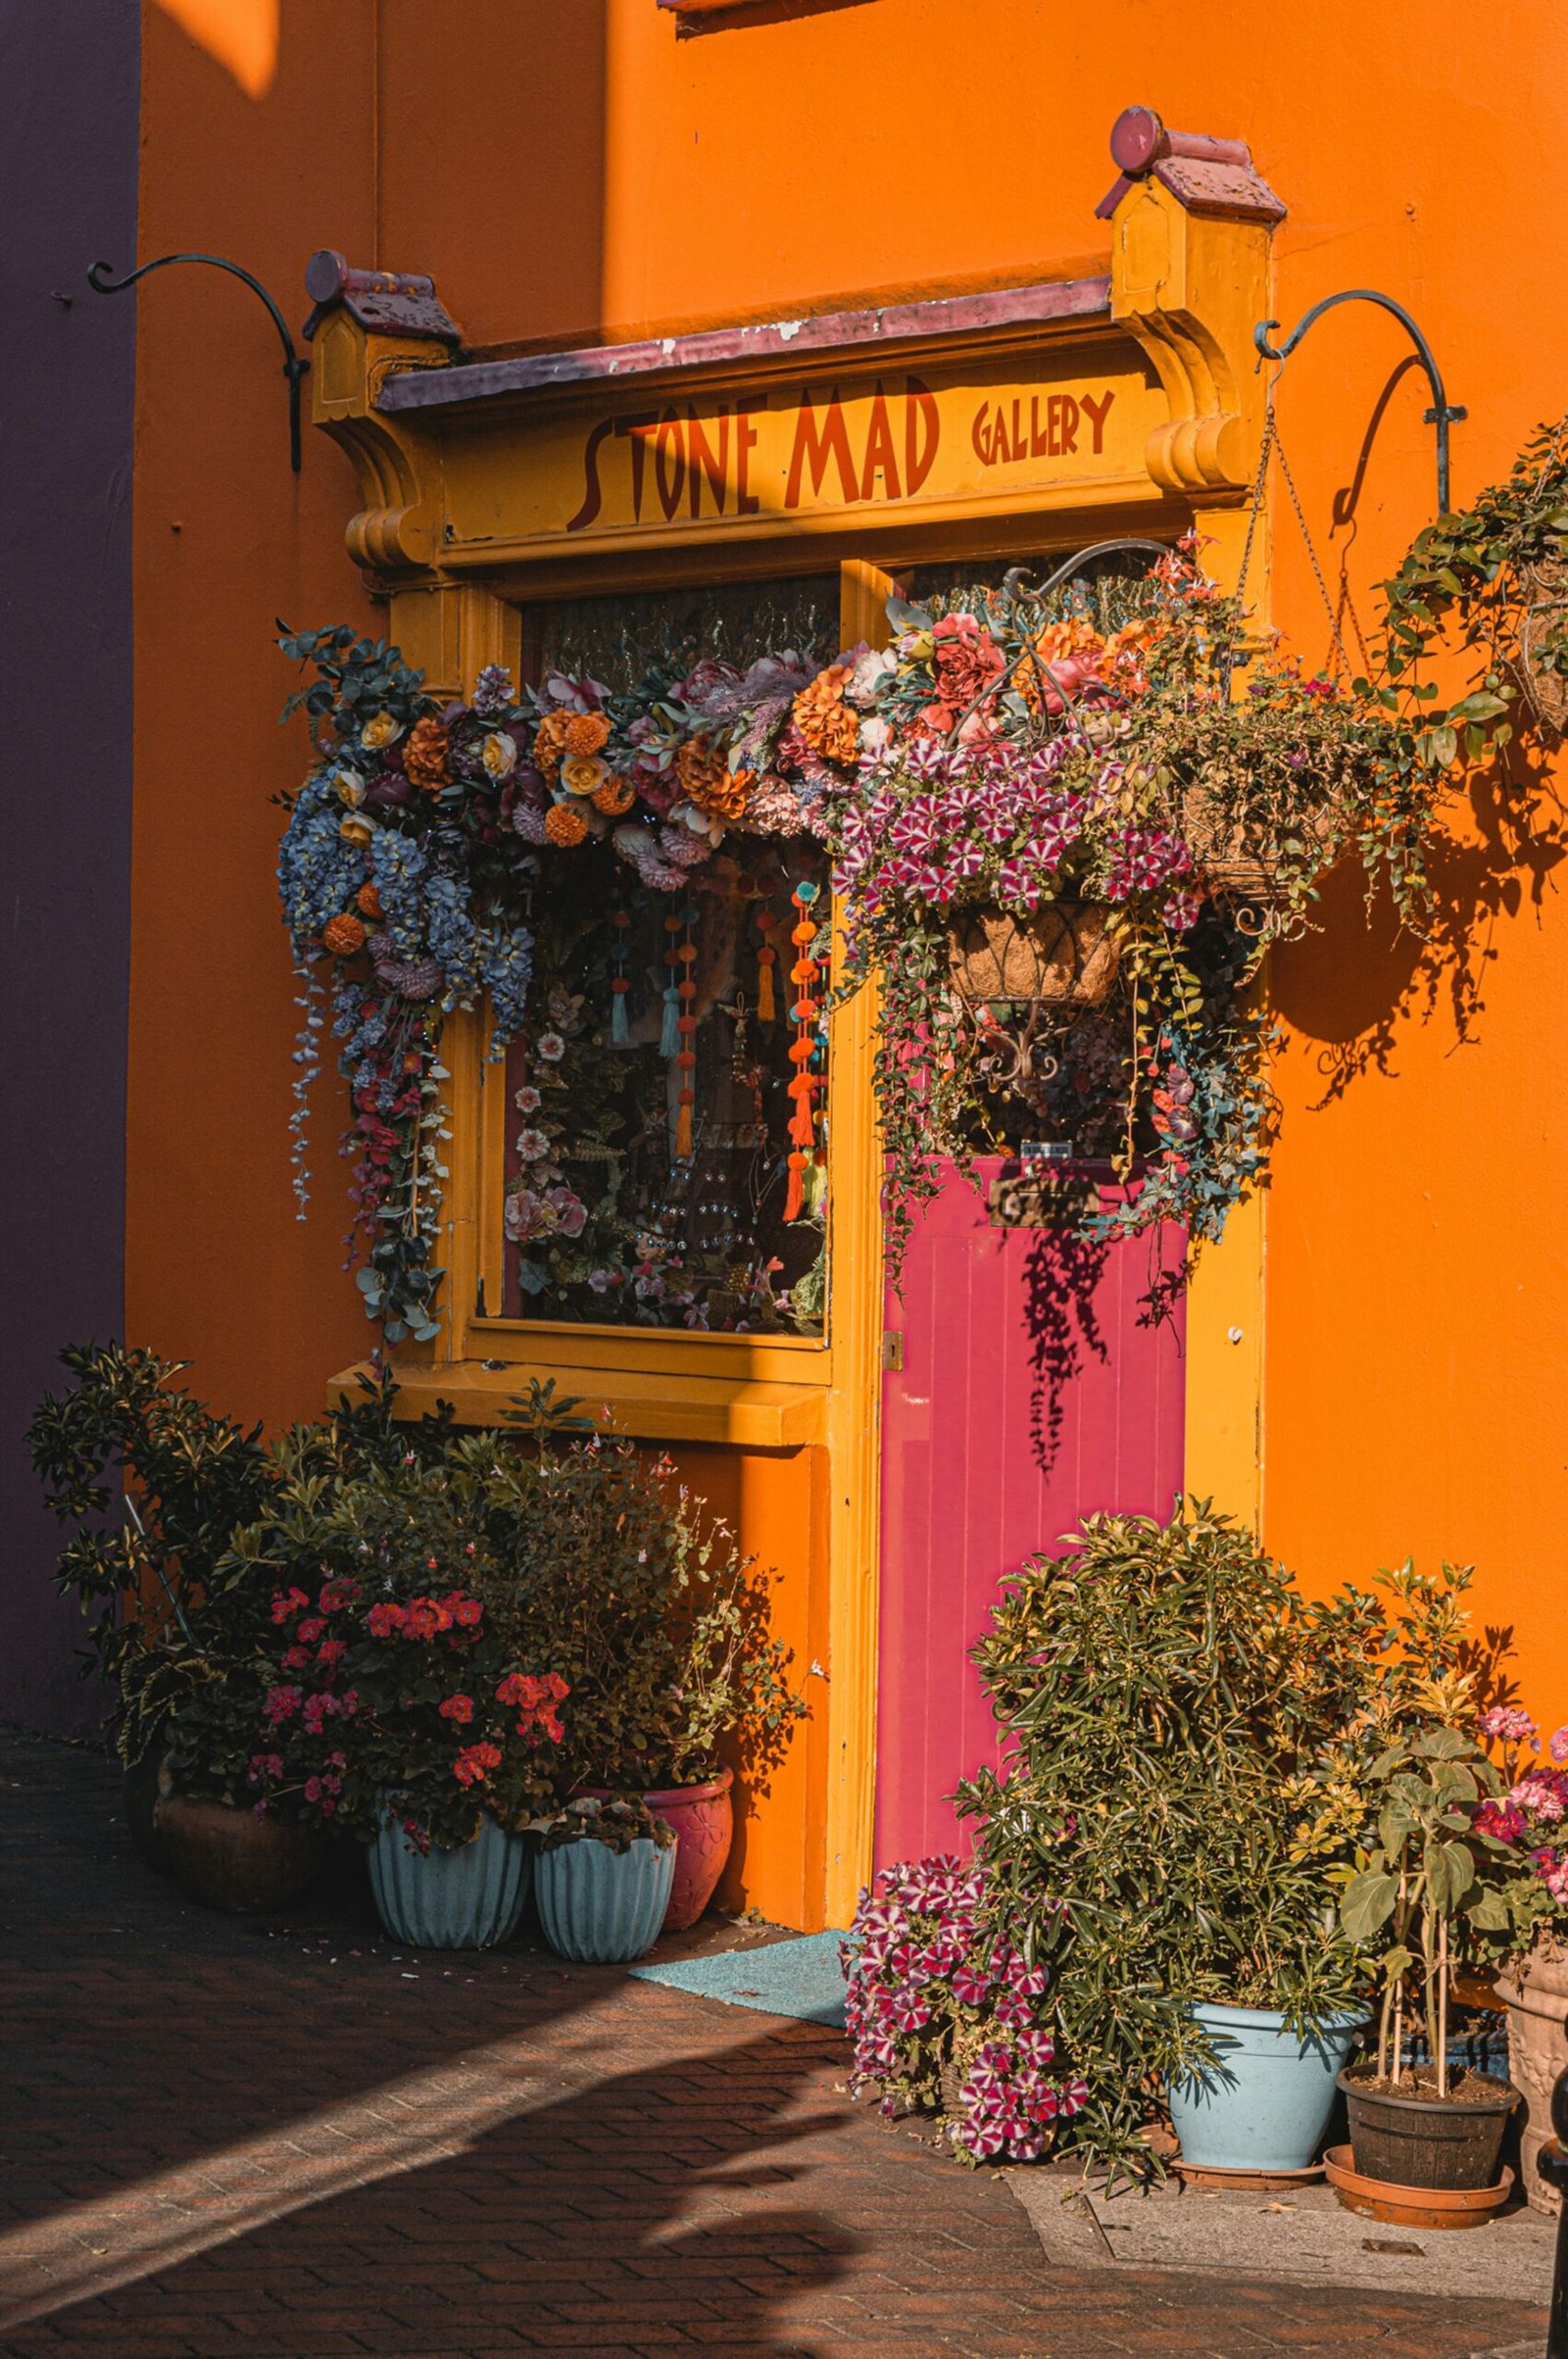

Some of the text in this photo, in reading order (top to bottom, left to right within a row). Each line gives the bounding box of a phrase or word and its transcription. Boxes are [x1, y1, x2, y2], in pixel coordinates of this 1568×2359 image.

[565, 375, 1115, 532] STONE MAD GALLERY
